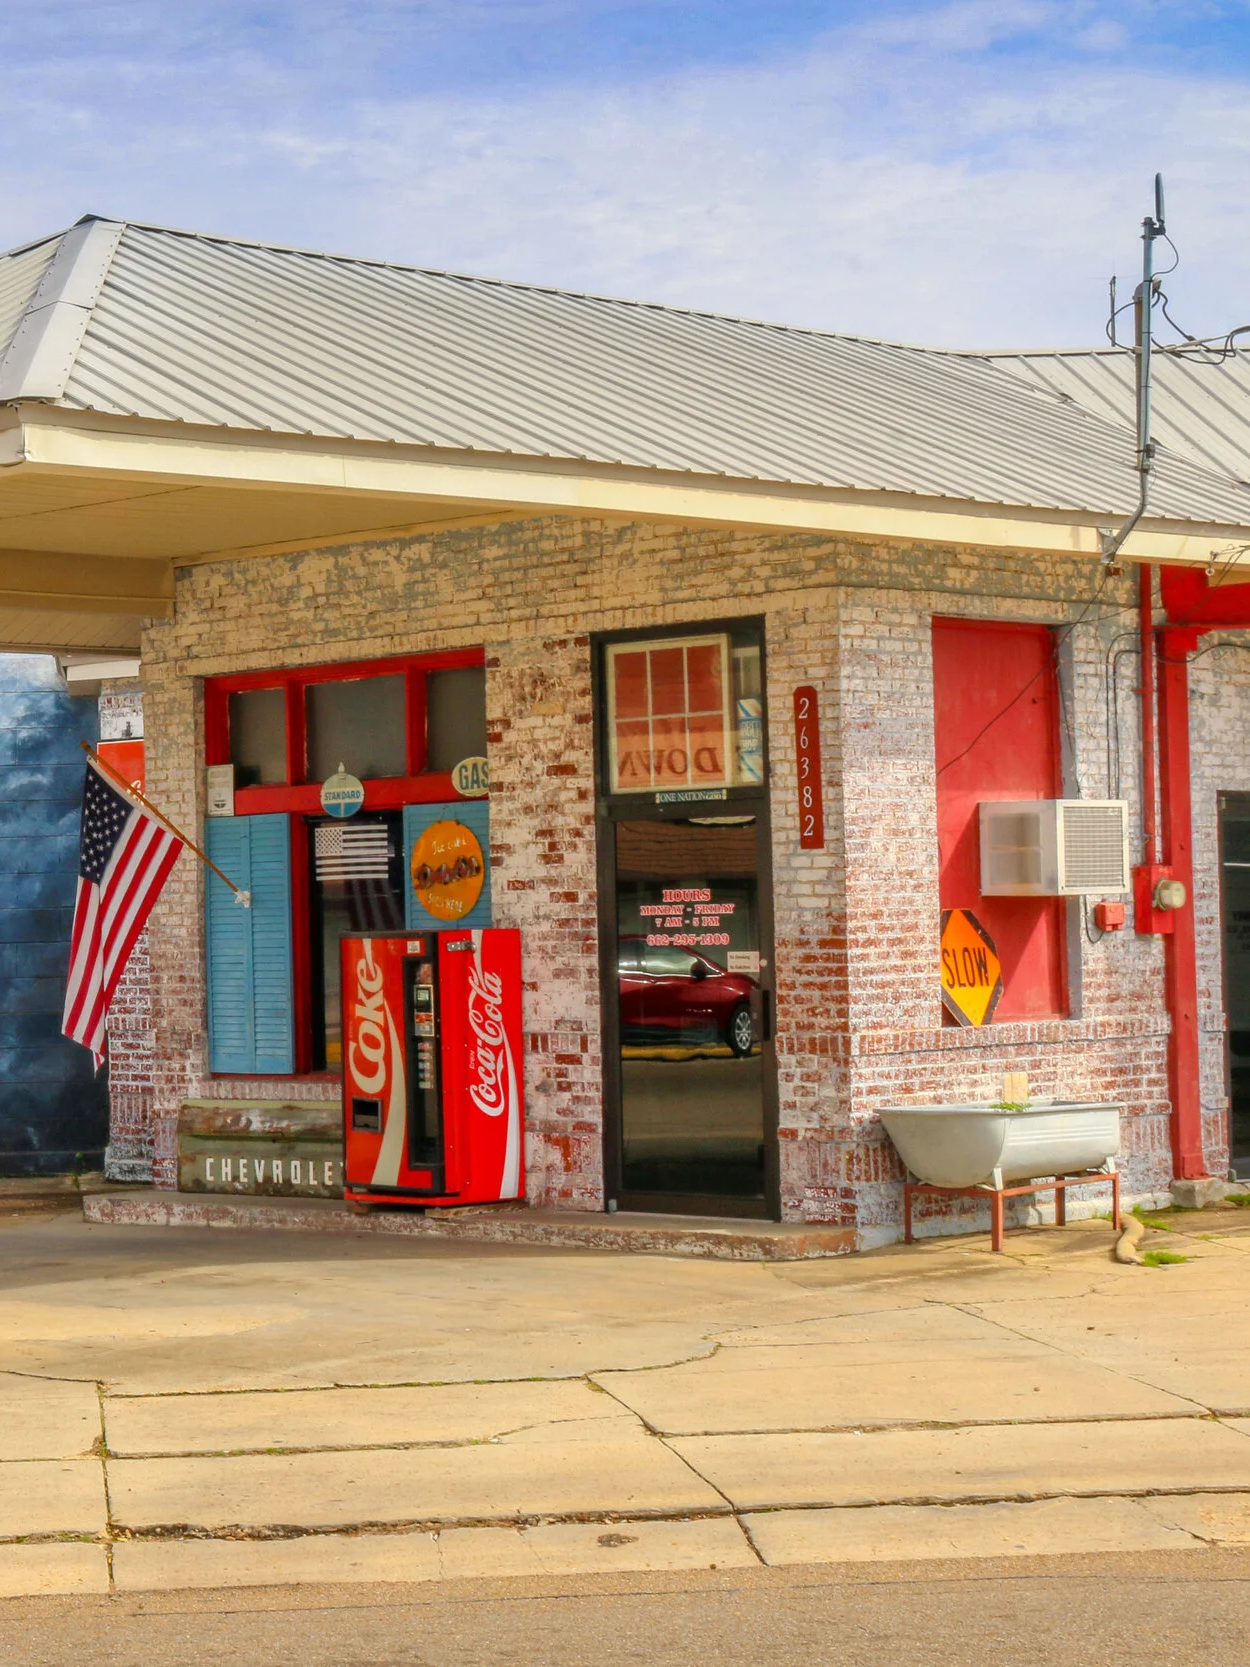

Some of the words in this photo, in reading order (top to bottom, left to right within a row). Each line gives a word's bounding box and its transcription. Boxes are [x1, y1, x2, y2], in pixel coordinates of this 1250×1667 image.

[458, 761, 489, 791] GAS
[324, 790, 361, 801] STANDARD
[659, 792, 677, 802] ONE
[677, 791, 706, 801] NATION
[662, 888, 711, 902] HOURS
[640, 905, 685, 916] MONDAY
[694, 903, 736, 914] FRIDAY
[655, 918, 663, 928] 7
[664, 917, 683, 927] AM
[701, 916, 720, 926] PM
[646, 933, 730, 946] 662-295-1309
[941, 946, 990, 990] SLOW
[349, 958, 386, 1094] Coke
[468, 966, 505, 1117] Coca-Cola
[205, 1157, 344, 1187] CHEVROLE
